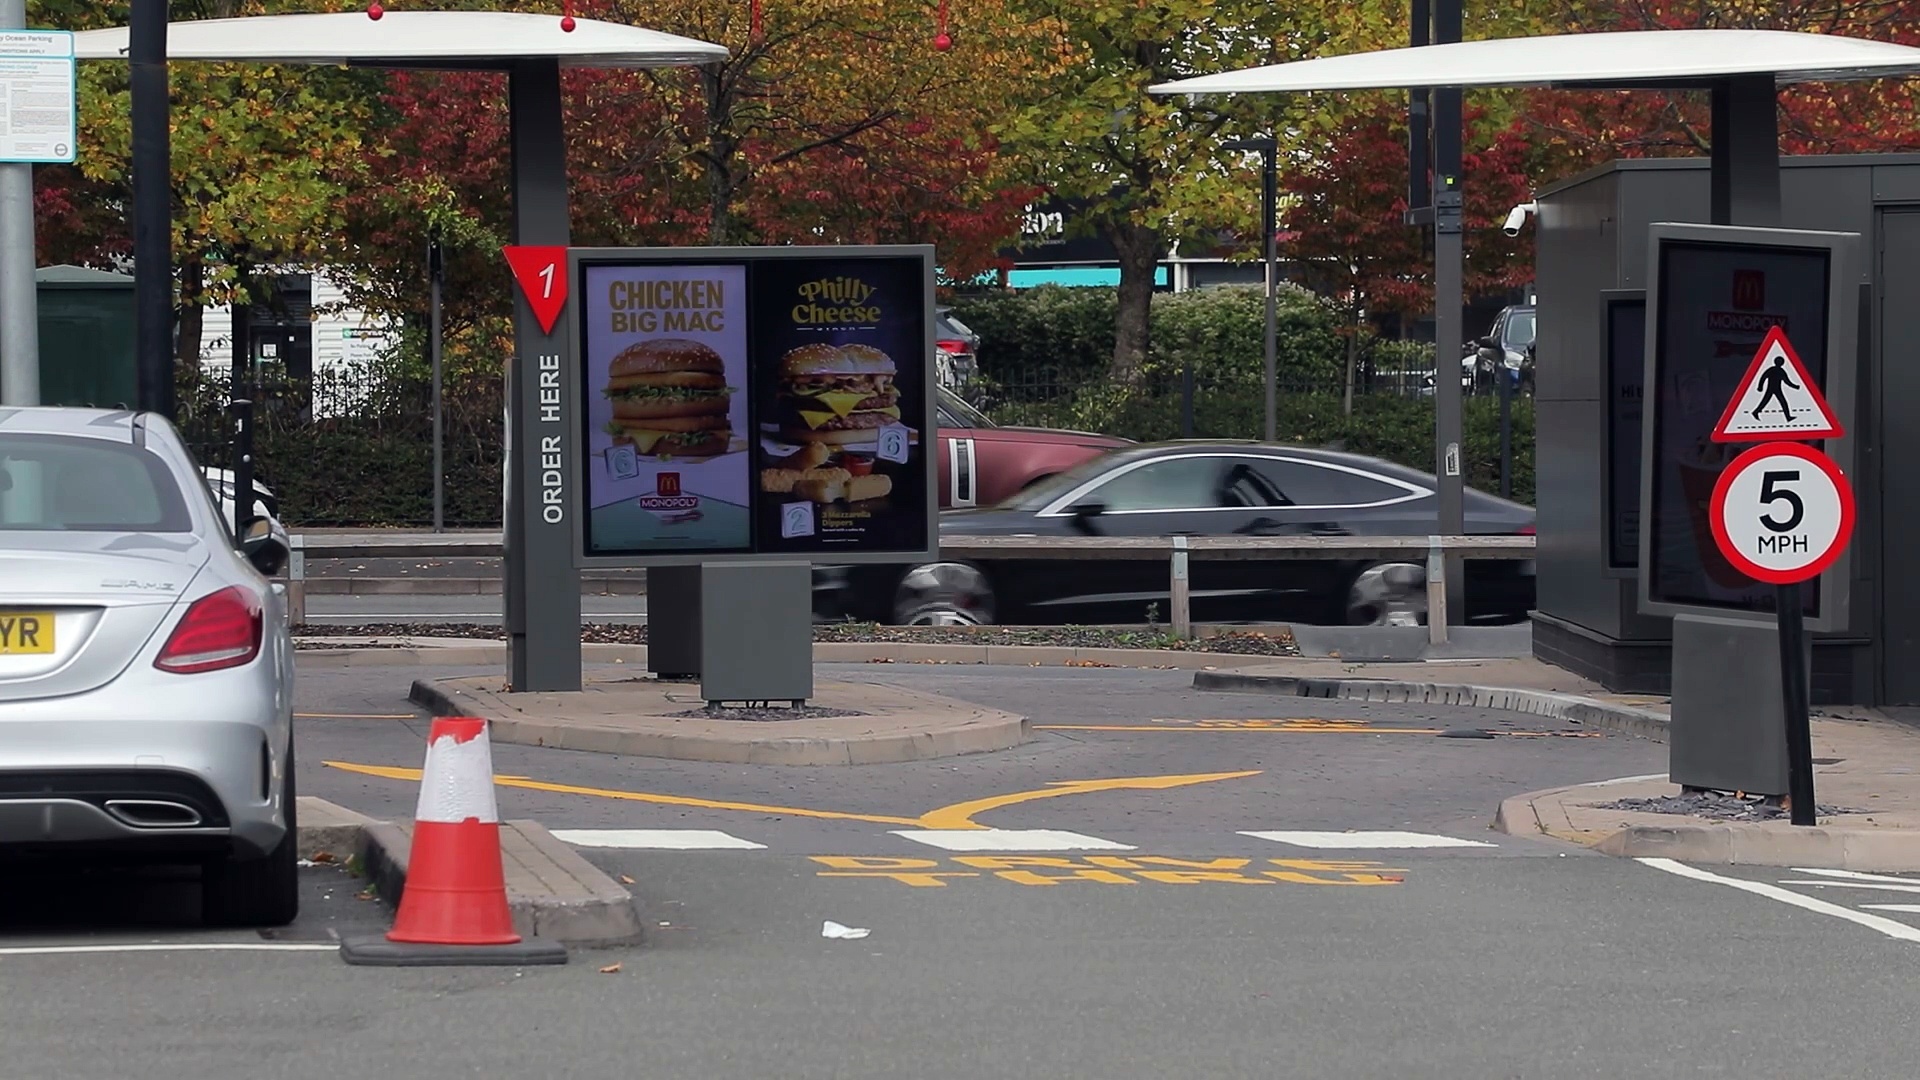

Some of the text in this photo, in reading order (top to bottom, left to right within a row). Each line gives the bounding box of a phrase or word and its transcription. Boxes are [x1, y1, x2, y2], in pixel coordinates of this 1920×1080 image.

[28, 35, 53, 43] Parking
[538, 263, 555, 299] 1
[798, 276, 878, 307] Philly
[609, 280, 724, 310] CHICKEN
[611, 310, 725, 333] BIG MAC
[791, 303, 882, 324] Cheese
[539, 354, 563, 524] ORDER HERE
[641, 498, 697, 508] MONOPOLY
[1758, 470, 1804, 533] 5
[822, 519, 854, 528] Dippers
[1757, 534, 1808, 554] MPH
[0, 617, 40, 648] YR
[807, 855, 1411, 872] DRIVE
[815, 869, 1402, 887] THRU
